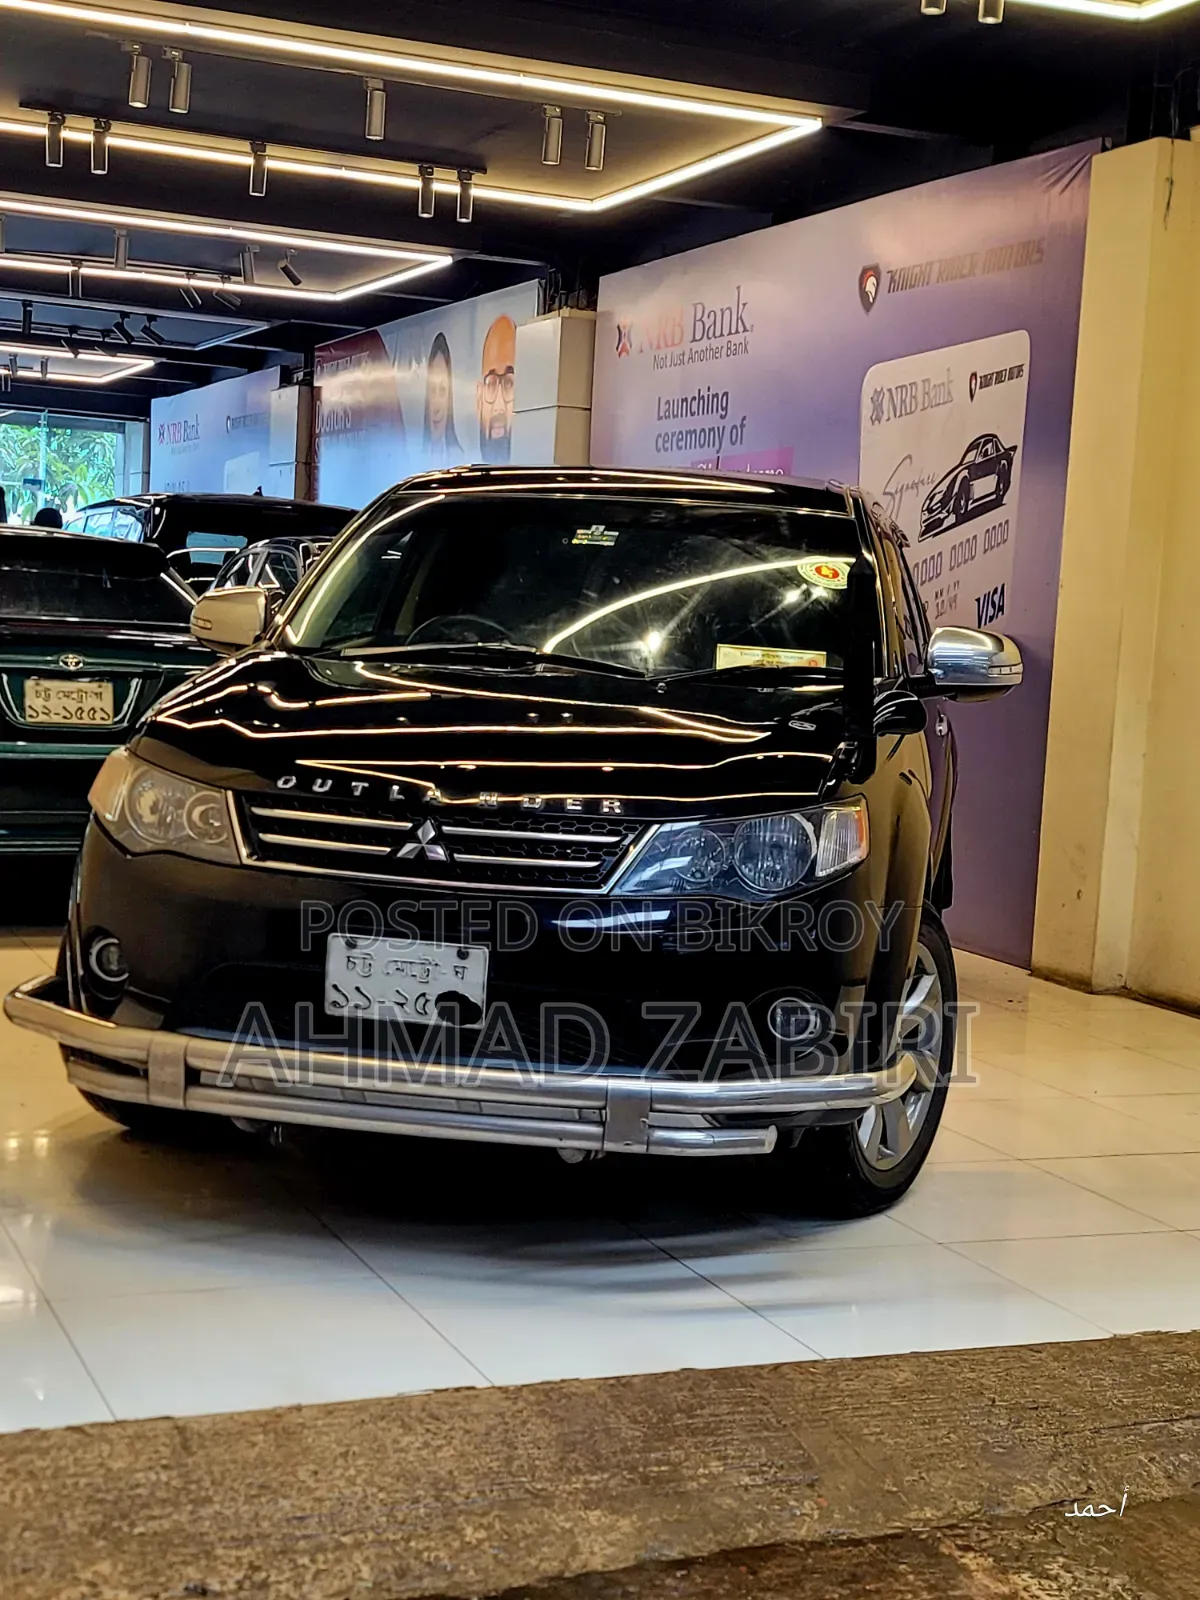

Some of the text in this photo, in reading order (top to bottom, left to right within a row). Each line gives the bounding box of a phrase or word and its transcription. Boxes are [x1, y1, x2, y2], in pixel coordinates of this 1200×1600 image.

[690, 285, 750, 343] Bank
[652, 336, 749, 370] Not Just Another Bank
[657, 385, 729, 421] Launching
[886, 367, 954, 422] NRB Bank
[655, 415, 747, 455] ceremony of
[949, 534, 978, 572] 0000
[983, 519, 1009, 555] 0000
[975, 582, 1005, 629] VISA
[28, 704, 111, 721] ১২-১৫৫১
[276, 775, 623, 815] OUTLANDER
